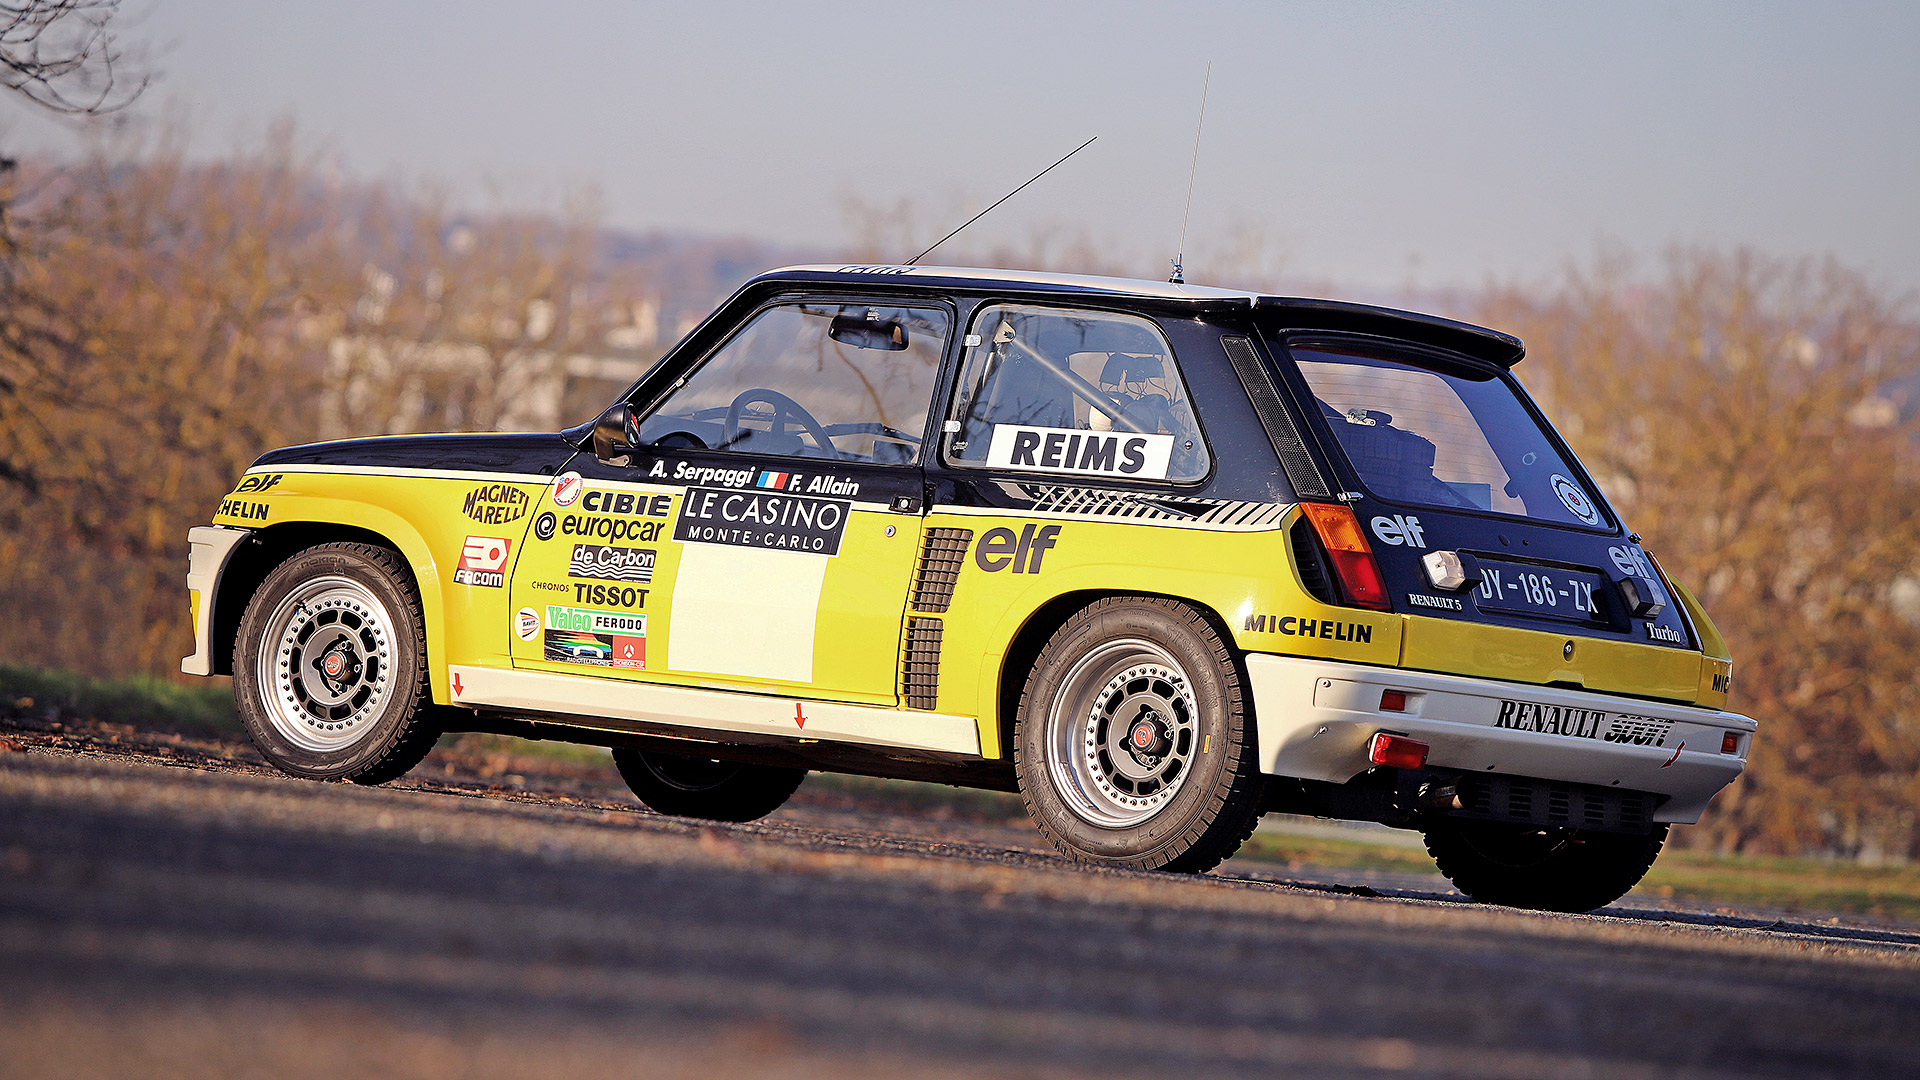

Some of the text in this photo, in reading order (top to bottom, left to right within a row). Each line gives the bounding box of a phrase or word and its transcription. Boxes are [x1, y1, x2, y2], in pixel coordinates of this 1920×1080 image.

[1010, 431, 1147, 474] REIMS
[236, 474, 283, 492] elf
[649, 460, 756, 488] A. Serpaggi
[788, 474, 860, 496] F. Allain
[217, 499, 270, 520] HELIN
[684, 490, 841, 531] LE CASINO
[562, 515, 665, 544] europcar
[1370, 514, 1427, 549] elf
[573, 544, 655, 568] de Carbon
[975, 524, 1062, 574] elf
[1608, 544, 1650, 579] elf
[531, 581, 650, 609] CHRONOS TISSOT
[1408, 593, 1463, 611] RENAULT 5
[548, 606, 591, 631] Valeo
[595, 616, 642, 630] FERODO
[1244, 614, 1373, 644] MICHELIN
[1646, 622, 1681, 643] Turbo
[1495, 700, 1606, 740] RENAULT
